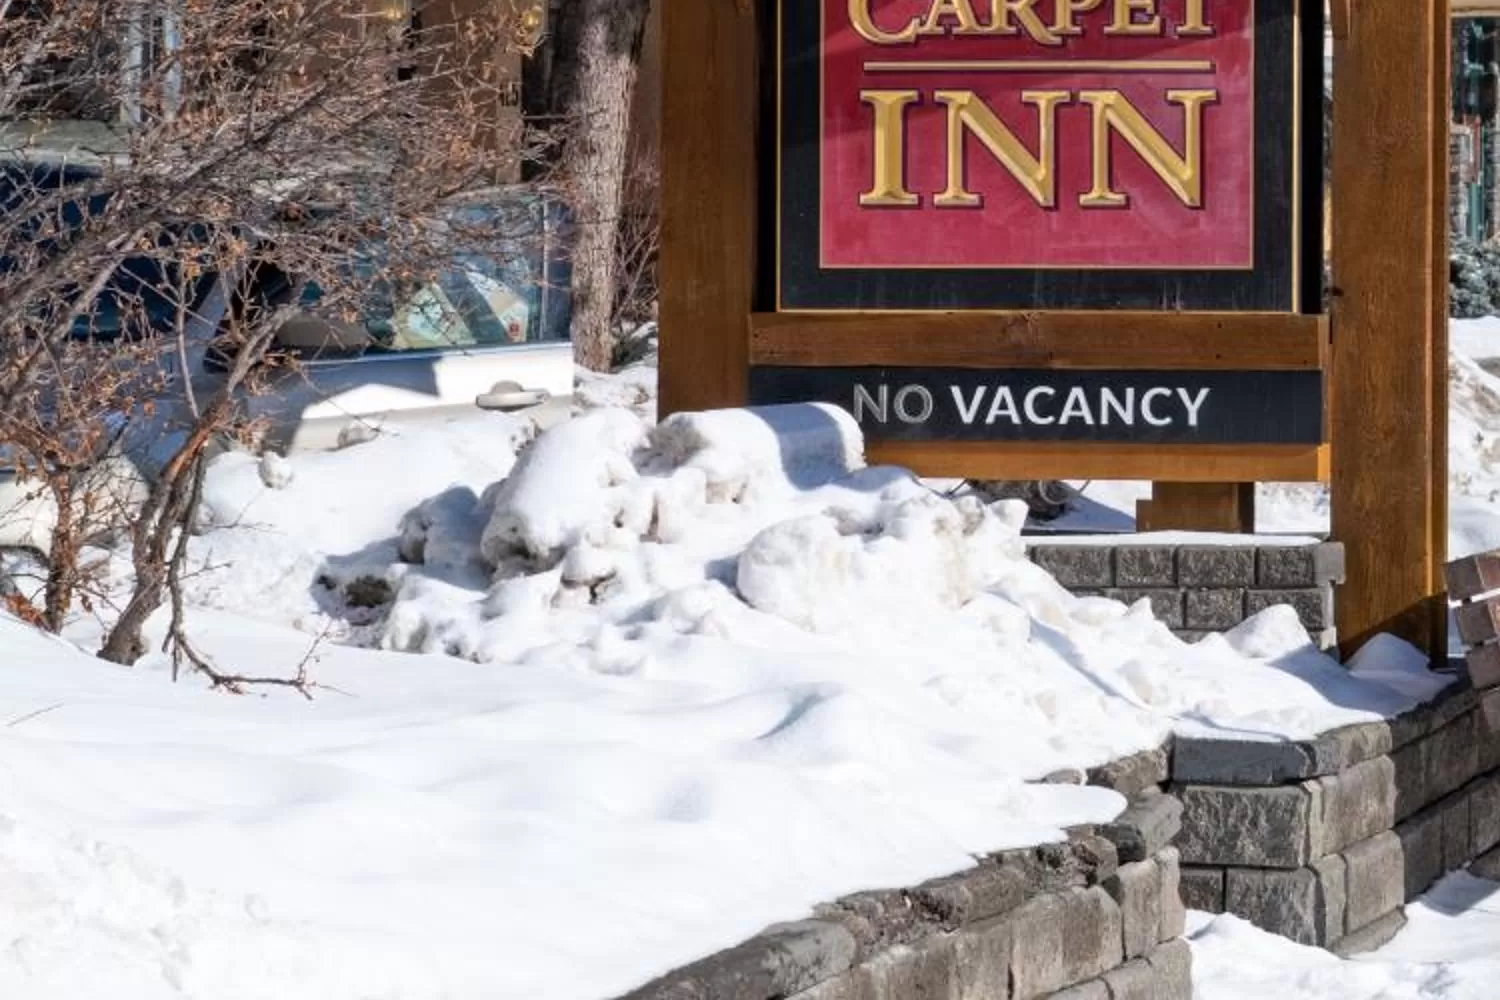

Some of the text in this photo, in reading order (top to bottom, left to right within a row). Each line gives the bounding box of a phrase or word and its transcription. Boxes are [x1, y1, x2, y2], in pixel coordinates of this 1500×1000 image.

[859, 89, 1217, 208] INN
[853, 383, 1211, 427] NO VACANCY
